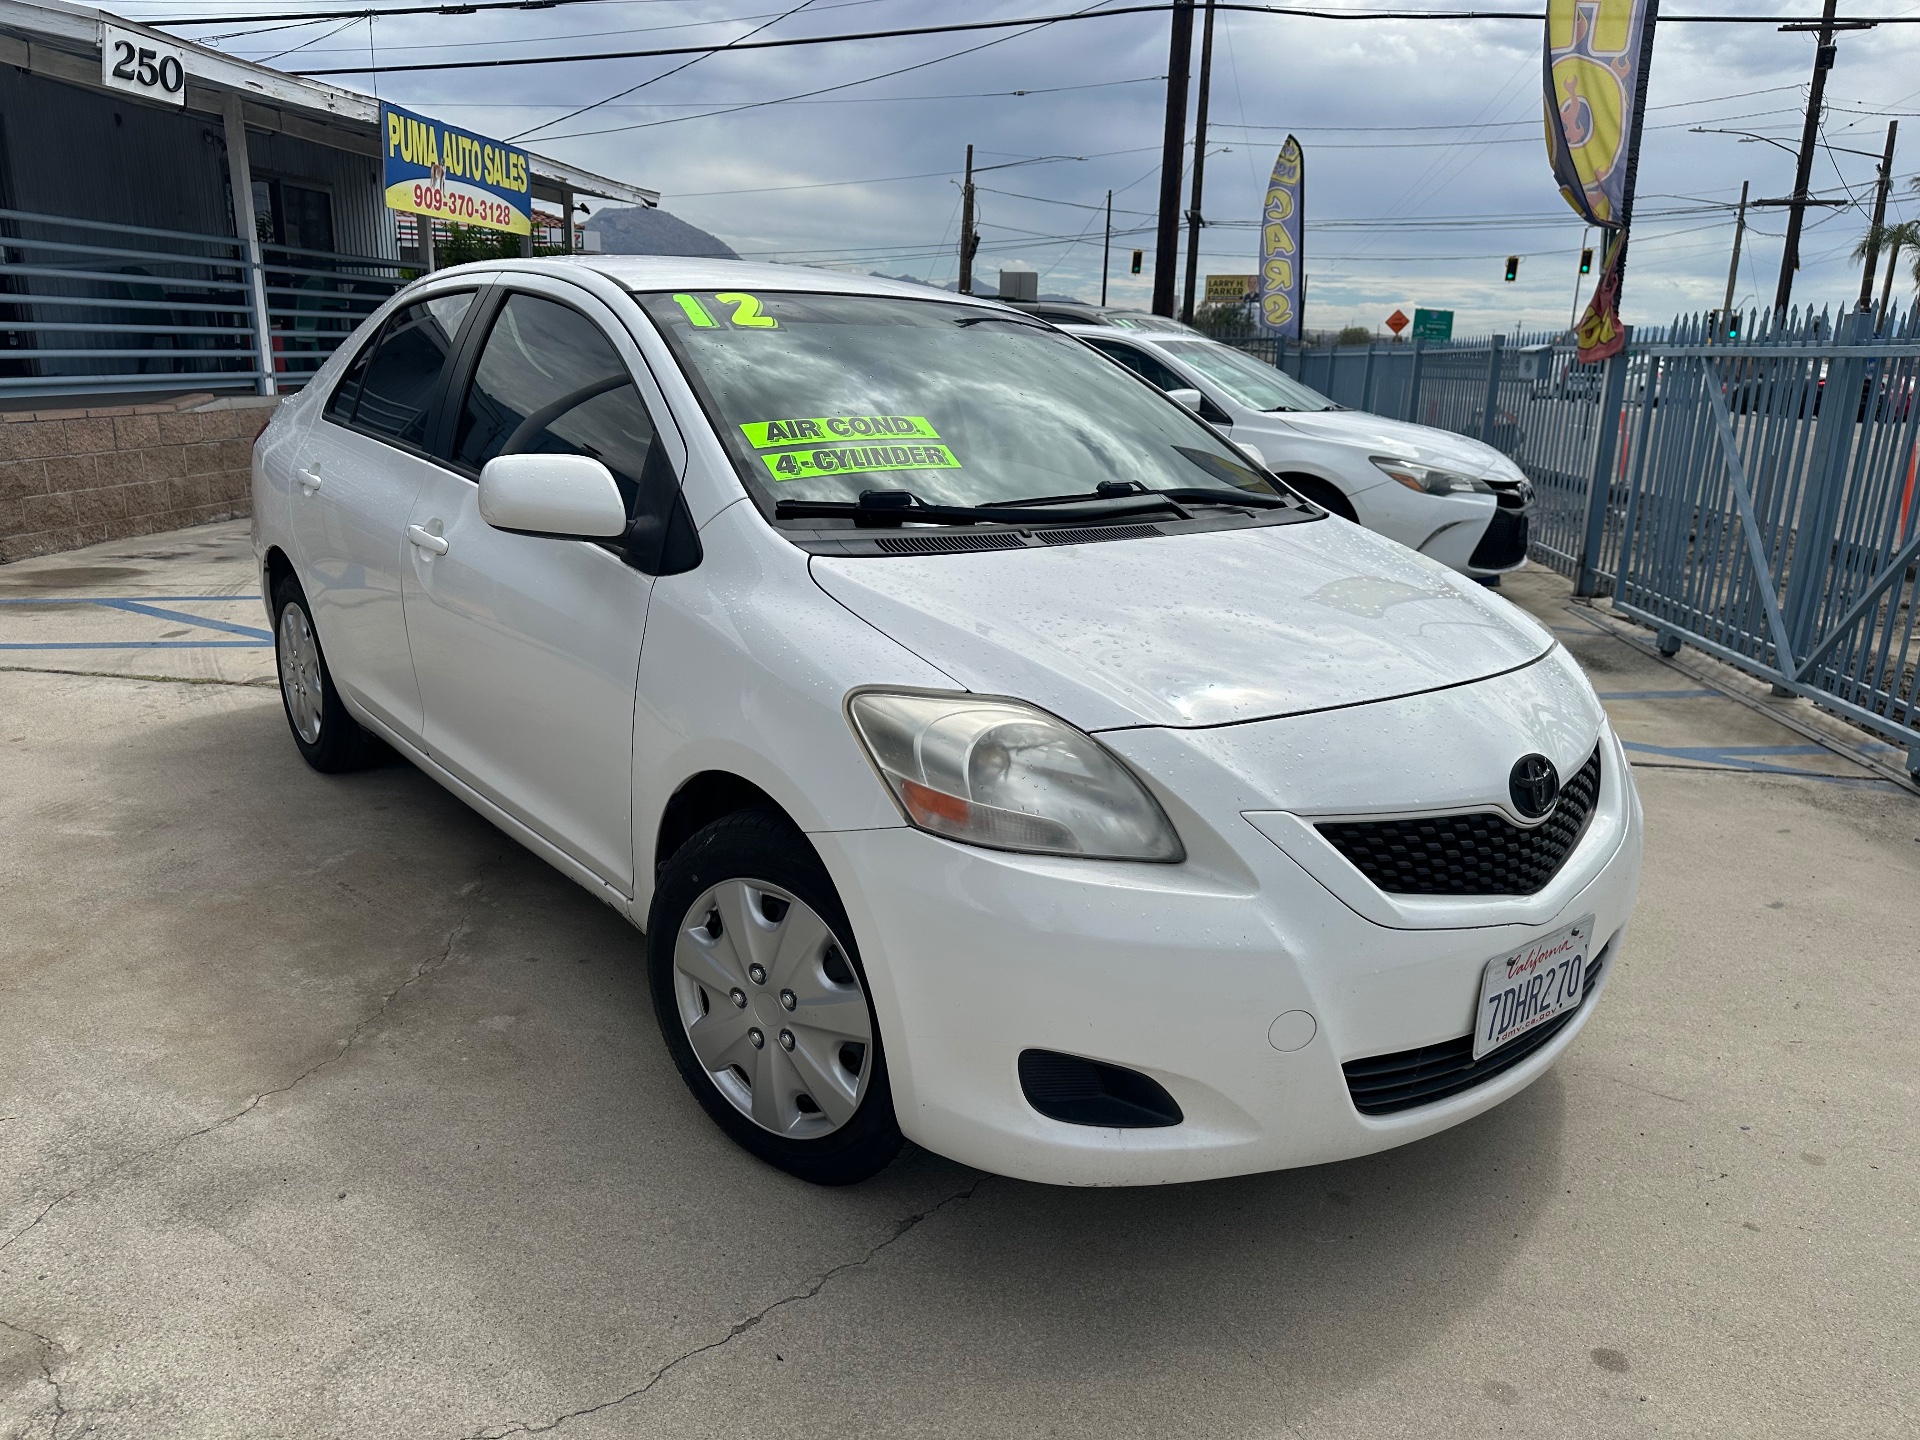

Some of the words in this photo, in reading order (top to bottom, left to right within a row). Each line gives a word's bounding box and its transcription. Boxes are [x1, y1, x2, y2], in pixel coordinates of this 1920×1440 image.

[113, 40, 183, 92] 250
[387, 112, 439, 168] PUMA
[443, 131, 482, 182] AUTO
[484, 144, 528, 194] SALES
[413, 184, 511, 226] 909-370-3128
[1208, 287, 1244, 295] PARKER
[672, 293, 778, 329] 12
[767, 419, 825, 442] AIR
[826, 417, 926, 437] COND.
[775, 447, 951, 475] 4-CYLINDER
[1507, 940, 1573, 980] California
[1487, 954, 1582, 1041] 7DHR270
[1501, 1007, 1557, 1041] dmv.ca.gov
